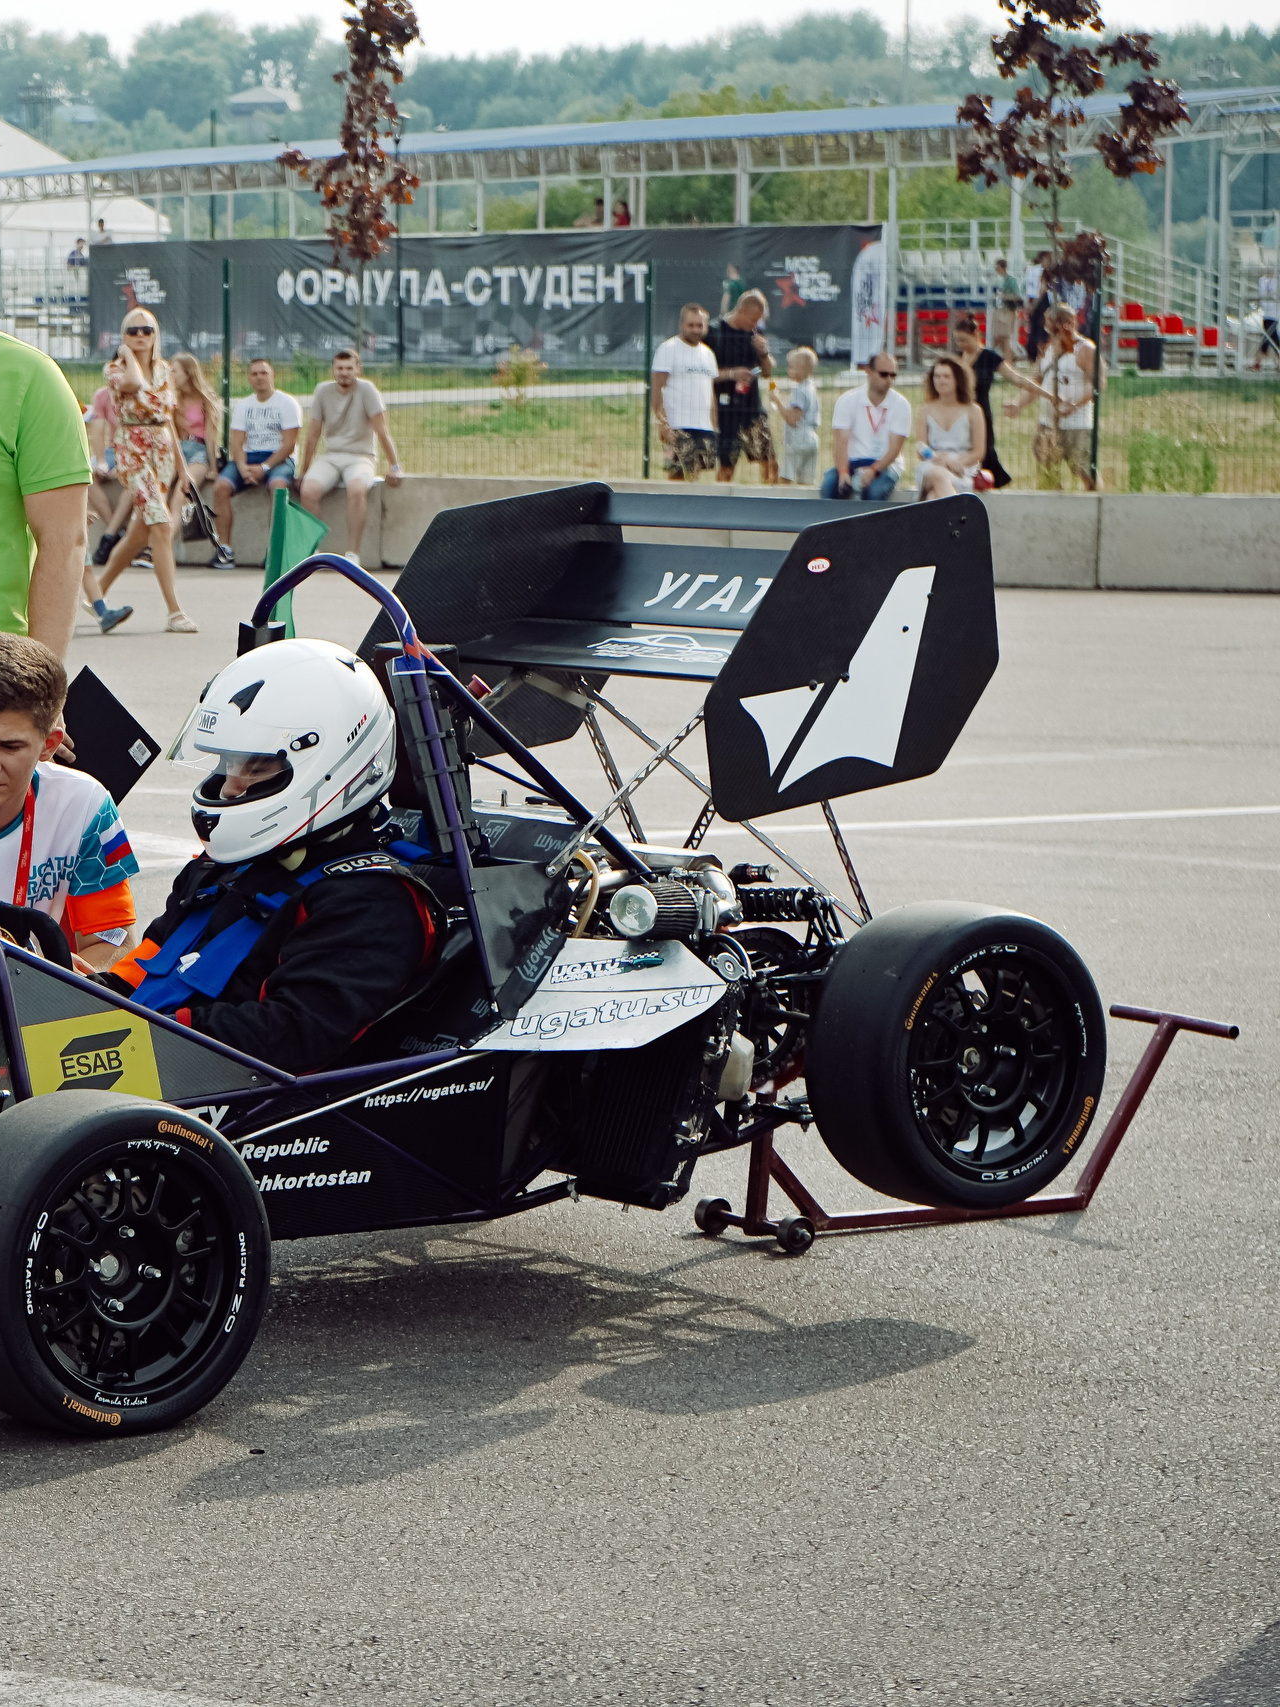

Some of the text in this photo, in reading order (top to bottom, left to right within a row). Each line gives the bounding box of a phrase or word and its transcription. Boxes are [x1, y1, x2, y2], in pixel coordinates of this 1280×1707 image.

[643, 571, 774, 615] УГАТ
[552, 958, 621, 978] UGATU
[509, 986, 712, 1040] ugatu.su
[61, 1049, 123, 1079] ESAB
[363, 1076, 495, 1110] https://ugatu.su/
[157, 1120, 210, 1149] Continental
[240, 1137, 330, 1162] Republic
[255, 1169, 371, 1192] shkortostan
[67, 1399, 122, 1426] Continental
